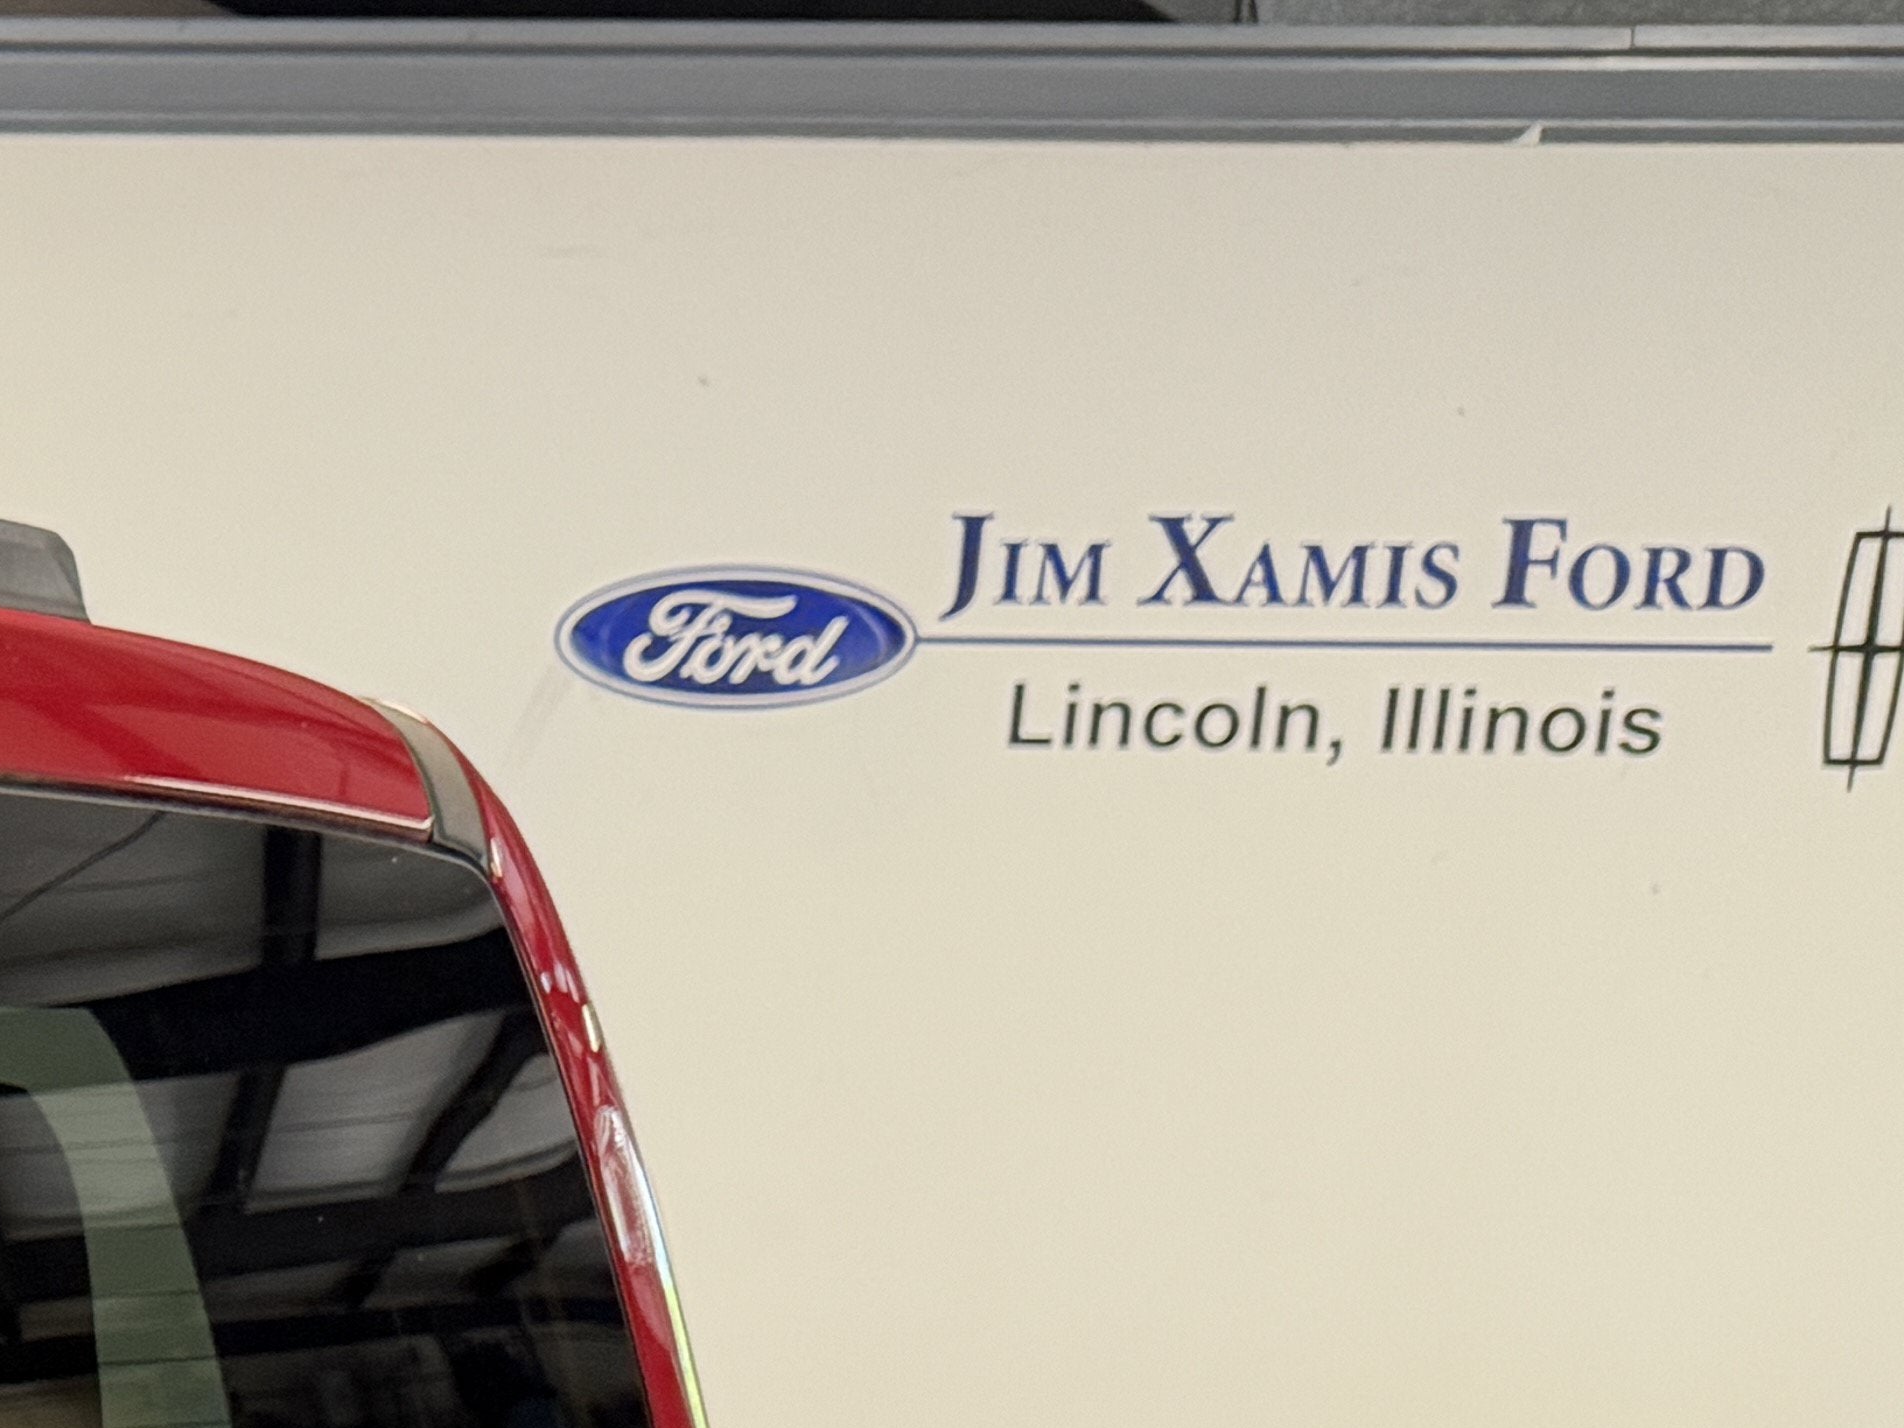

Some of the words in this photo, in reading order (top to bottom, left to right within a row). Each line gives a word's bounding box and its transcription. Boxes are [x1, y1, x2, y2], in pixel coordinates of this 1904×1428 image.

[938, 513, 1107, 621] JIM
[1138, 514, 1460, 609] XAMIS
[1493, 516, 1767, 610] FORD
[622, 588, 850, 686] Ford
[1008, 682, 1342, 764] Lincoln,
[1381, 686, 1662, 756] Illinois
